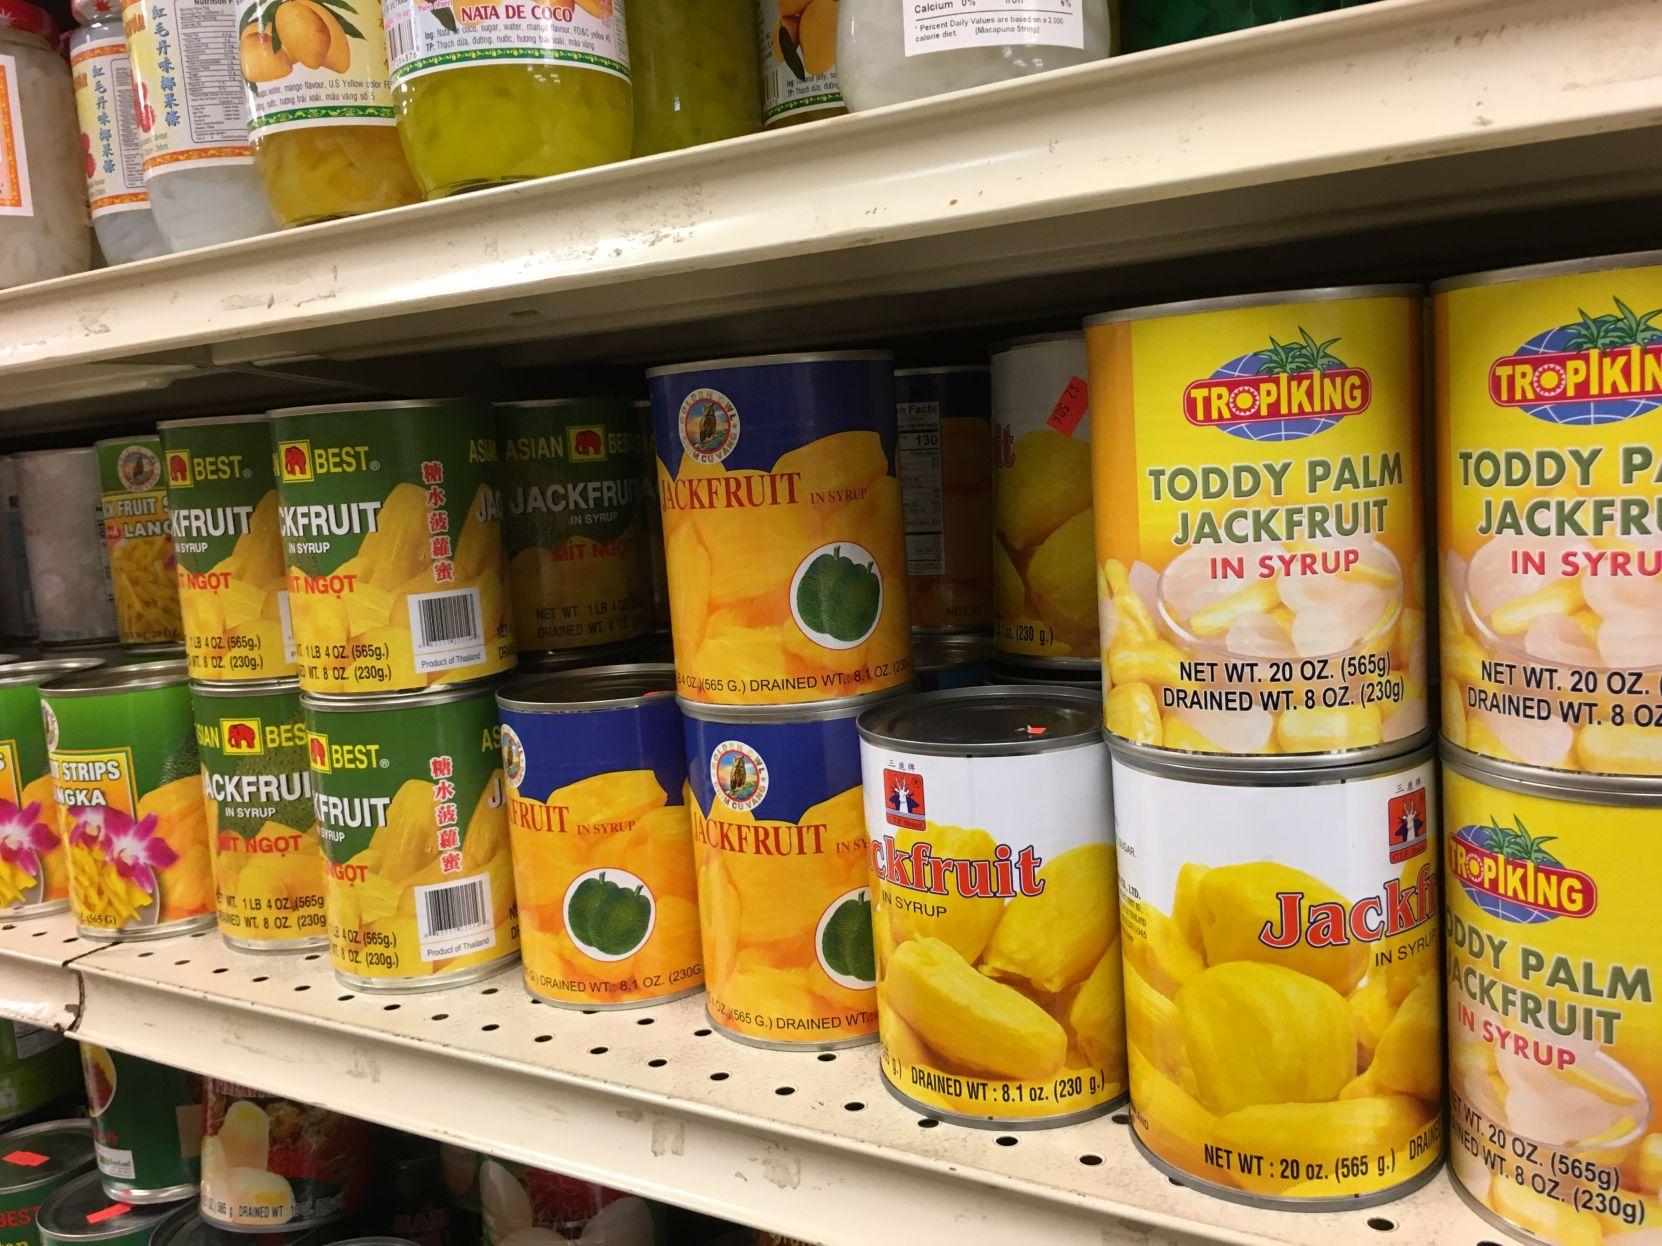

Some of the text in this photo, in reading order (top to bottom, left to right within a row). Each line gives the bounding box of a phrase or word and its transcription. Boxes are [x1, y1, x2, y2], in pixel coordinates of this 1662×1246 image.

[461, 5, 500, 22] NATA
[504, 4, 527, 19] DE
[531, 5, 573, 22] COCO
[914, 1, 953, 14] Calcium
[915, 32, 940, 42] calorie
[974, 26, 1015, 36] (Macapuno
[919, 21, 948, 32] Percent
[949, 19, 969, 28] Daily
[970, 16, 995, 25] Values
[1190, 369, 1363, 423] TROPIKING
[505, 435, 564, 460] ASIAN
[916, 434, 938, 447] 130
[193, 455, 242, 481] BEST
[314, 445, 369, 475] BEST
[1458, 447, 1604, 488] TODDY
[1148, 451, 1404, 502] TODDY PALM
[662, 471, 801, 512] JACKFRUIT
[810, 487, 868, 505] IN SYRUP
[1171, 498, 1389, 546] JACKFRUIT
[1477, 498, 1662, 538] JACKFR
[296, 542, 331, 554] SYRUP
[1209, 548, 1361, 580] IN SYRUP
[1510, 550, 1546, 576] IN
[304, 574, 357, 599] NGỌT
[227, 634, 262, 651] (565g.)
[351, 643, 390, 661] (565g.)
[229, 654, 264, 671] (230g.)
[354, 664, 392, 683] (230g.)
[421, 659, 447, 669] Product
[1179, 650, 1392, 684] NET WT. 20 OZ. (565g)
[749, 676, 817, 692] DRAINED
[853, 667, 871, 683] 8.1
[1481, 659, 1650, 695] NET WT. 20 OZ.
[1163, 675, 1405, 712] DRAINED WT. 8 OZ. (230g)
[1468, 686, 1625, 727] DRAINED WT. 8
[331, 744, 380, 769] BEST
[62, 759, 121, 782] STRIPS
[225, 807, 276, 818] IN SYRUP
[576, 820, 636, 836] IN SYRUP
[693, 809, 828, 857] JACKFRUIT
[244, 834, 303, 858] NGỌT
[1449, 840, 1614, 914] TROPIKING
[249, 898, 273, 911] LB 4
[881, 889, 948, 918] IN SYRUP
[263, 917, 270, 930] 8
[274, 917, 292, 929] OZ.
[363, 931, 397, 949] (565g.)
[427, 946, 454, 958] Product
[366, 951, 399, 969] (230g.)
[1374, 948, 1394, 967] IN
[540, 974, 665, 992] DRAINED 8.1 OZ.
[1521, 945, 1652, 1004] PALM
[755, 1014, 773, 1030] G.)
[776, 1016, 842, 1031] DRAINED
[1457, 1001, 1576, 1071] IN SYRUP
[911, 1065, 1105, 1104] DRAINED WT 8.1 oz. (230 g.)
[1464, 1102, 1620, 1193] WT. 20 OZ. (565g)
[1204, 1143, 1396, 1184] NET WT 20 oz. (565 g.)
[1482, 1145, 1646, 1226] WT. 8 OZ. (230g)
[239, 1205, 270, 1218] DRAINED
